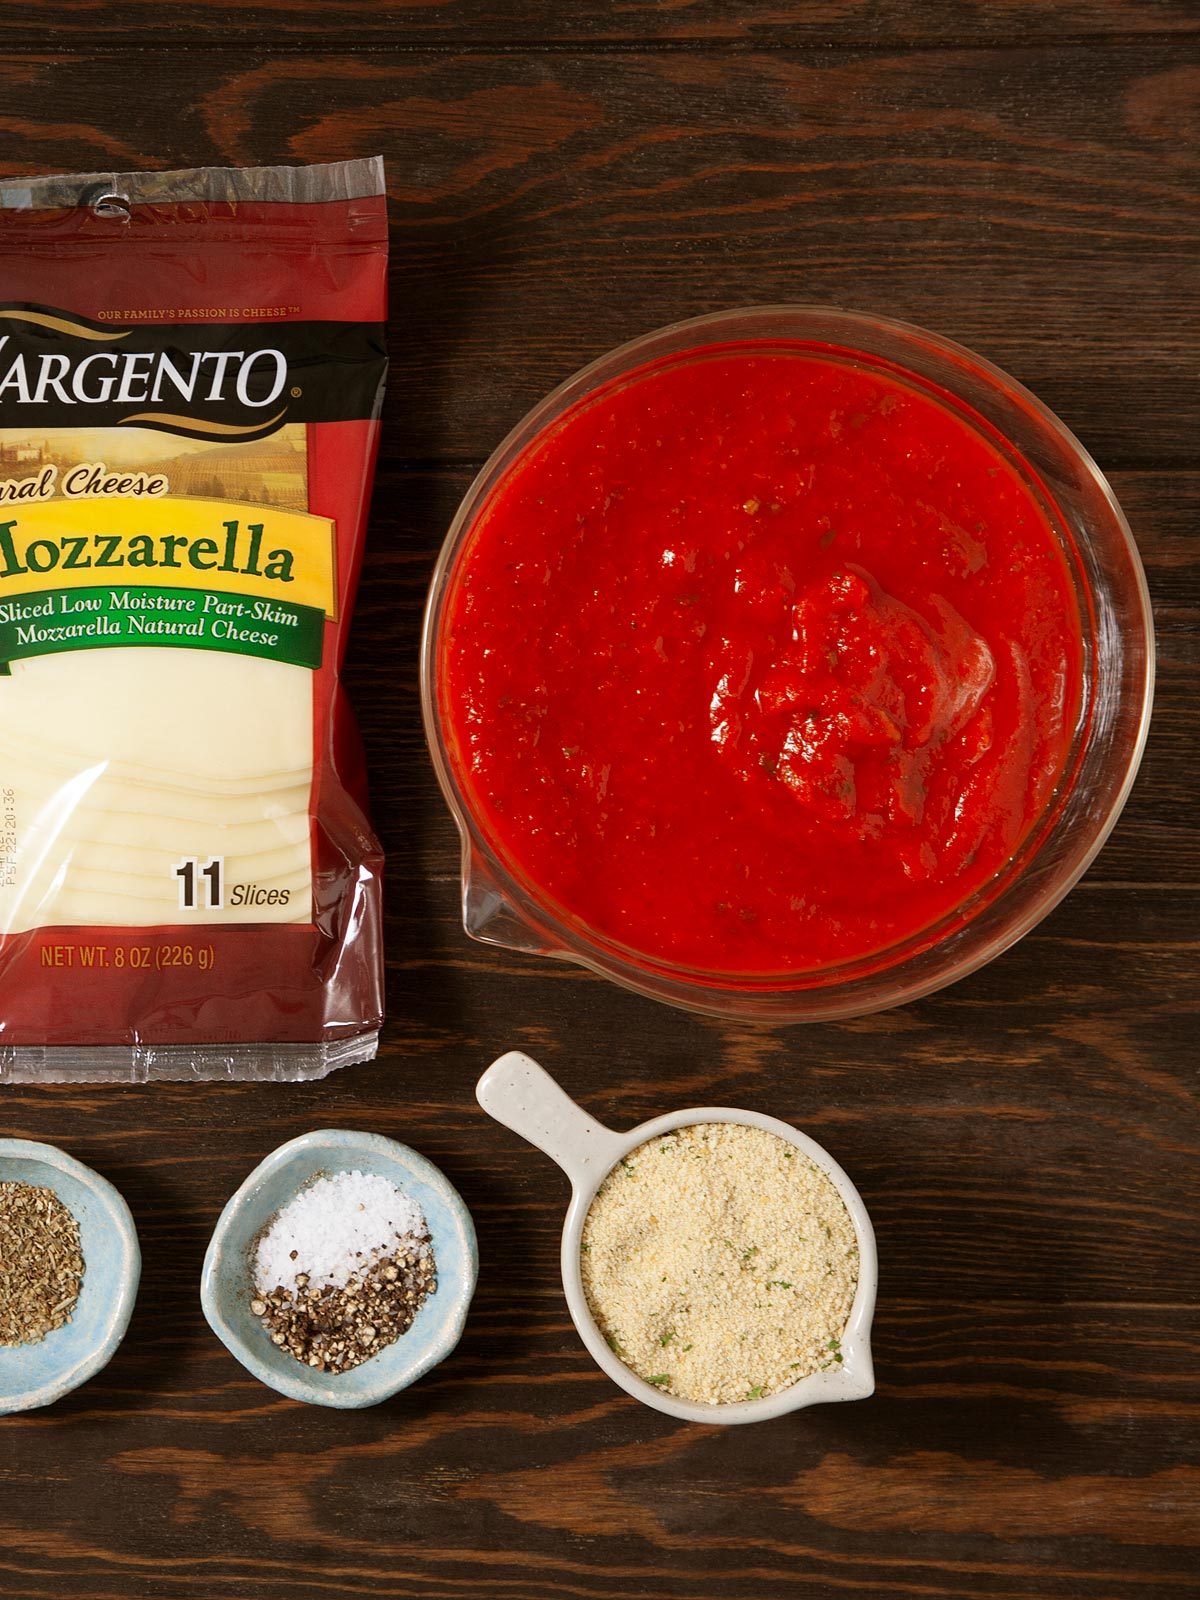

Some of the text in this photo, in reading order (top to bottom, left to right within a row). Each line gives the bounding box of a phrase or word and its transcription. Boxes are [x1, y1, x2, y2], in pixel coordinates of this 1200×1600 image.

[98, 310, 121, 320] OUR
[124, 309, 175, 319] FAMILY'S
[178, 308, 227, 318] PASSION
[229, 308, 240, 318] IS
[66, 467, 164, 496] Cheese
[60, 595, 102, 614] Low
[109, 592, 196, 612] Moisture
[202, 595, 299, 627] Part-Skim
[16, 615, 279, 646] Mozzarella Natural Cheese
[176, 861, 290, 907] 11 Slices
[41, 944, 215, 971] NET WT. 8 OZ (226 g)
